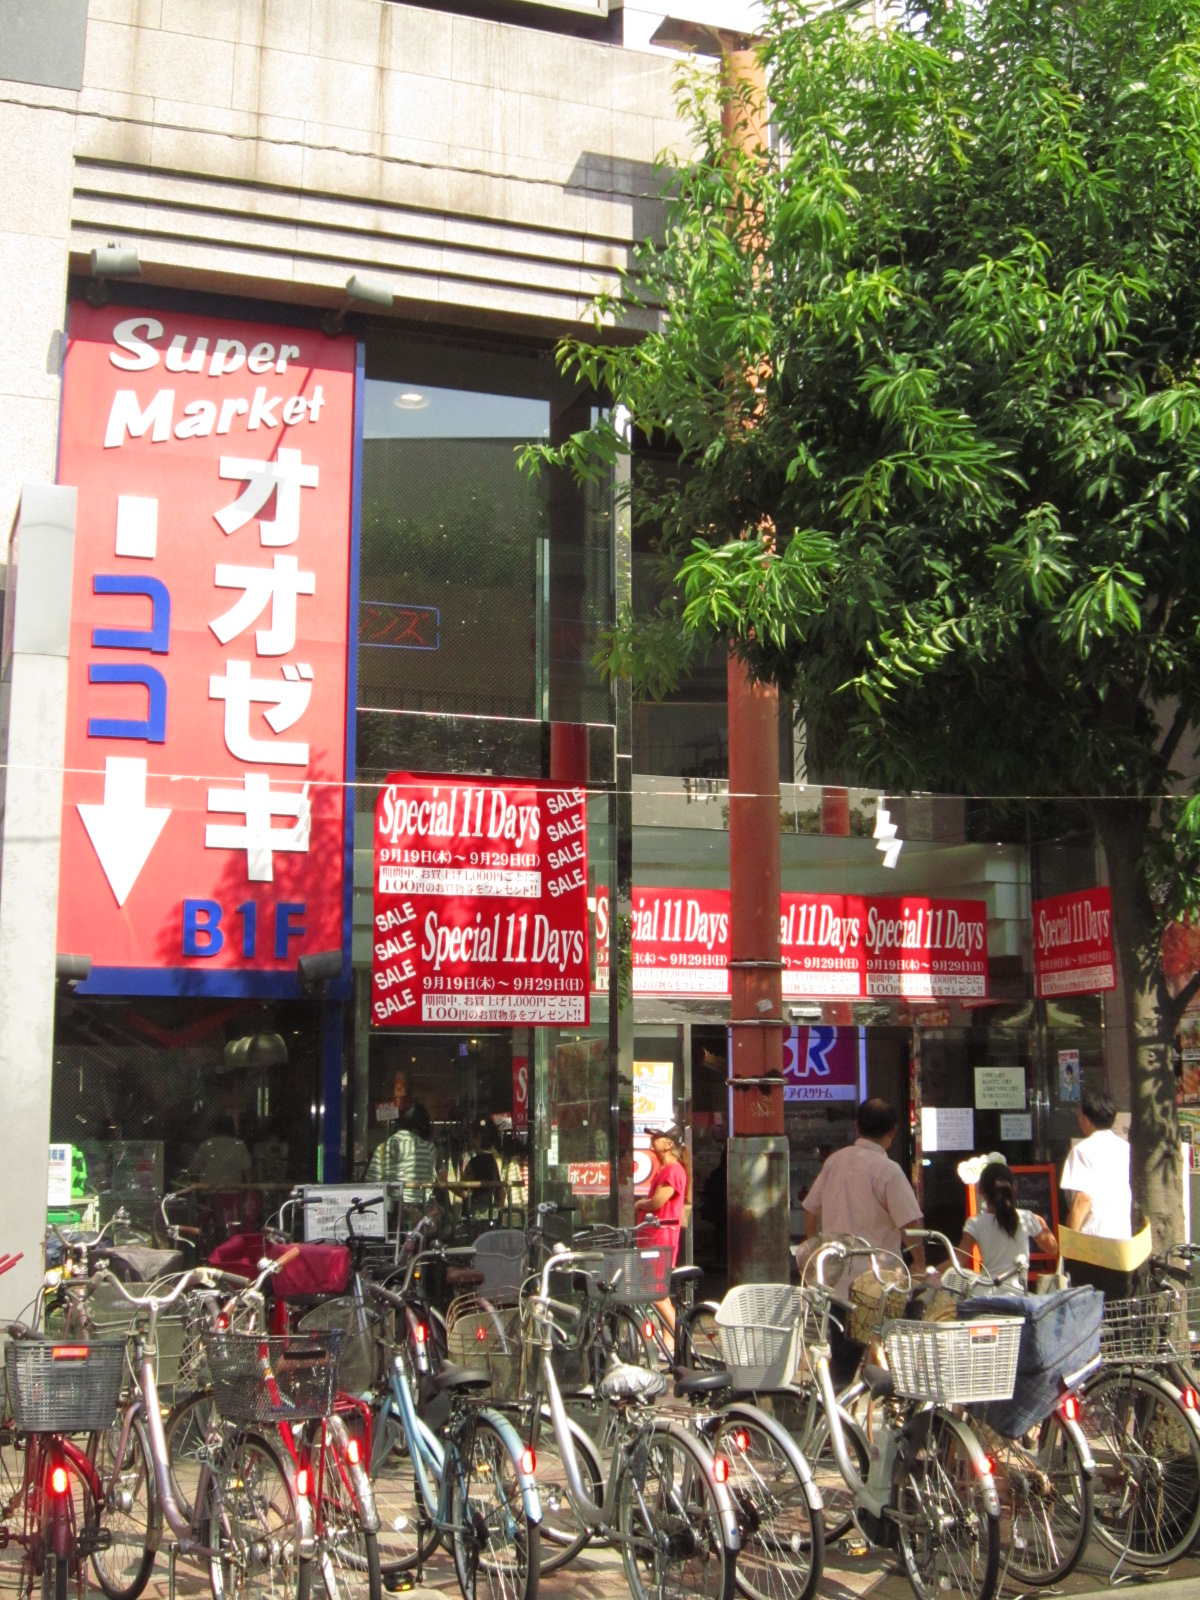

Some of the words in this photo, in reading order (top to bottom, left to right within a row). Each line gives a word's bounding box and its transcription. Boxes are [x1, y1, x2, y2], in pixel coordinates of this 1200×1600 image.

[110, 317, 300, 377] Super
[104, 385, 325, 449] Market
[204, 447, 319, 882] オオゼキ
[379, 784, 457, 843] Special
[457, 789, 485, 838] 11
[488, 790, 541, 848] Days
[547, 786, 586, 815] SALE
[547, 814, 586, 842] SALE
[547, 841, 586, 870] SALE
[547, 869, 587, 898] SALE
[182, 898, 306, 959] B1F
[375, 902, 417, 932] SALE
[422, 910, 500, 970] Special
[502, 912, 528, 963] 11
[530, 914, 584, 972] Days
[661, 898, 682, 942] 11
[684, 899, 729, 950] Days
[796, 903, 817, 946] 11
[818, 904, 860, 954] Days
[865, 906, 924, 954] Special
[924, 908, 943, 949] 11
[945, 909, 984, 956] Days
[1039, 905, 1072, 955] Special
[1072, 902, 1084, 943] 11
[1084, 900, 1110, 947] Days
[374, 930, 417, 961] SALE
[374, 959, 417, 990] SALE
[374, 988, 417, 1019] SALE
[570, 1170, 606, 1184] ポイント
